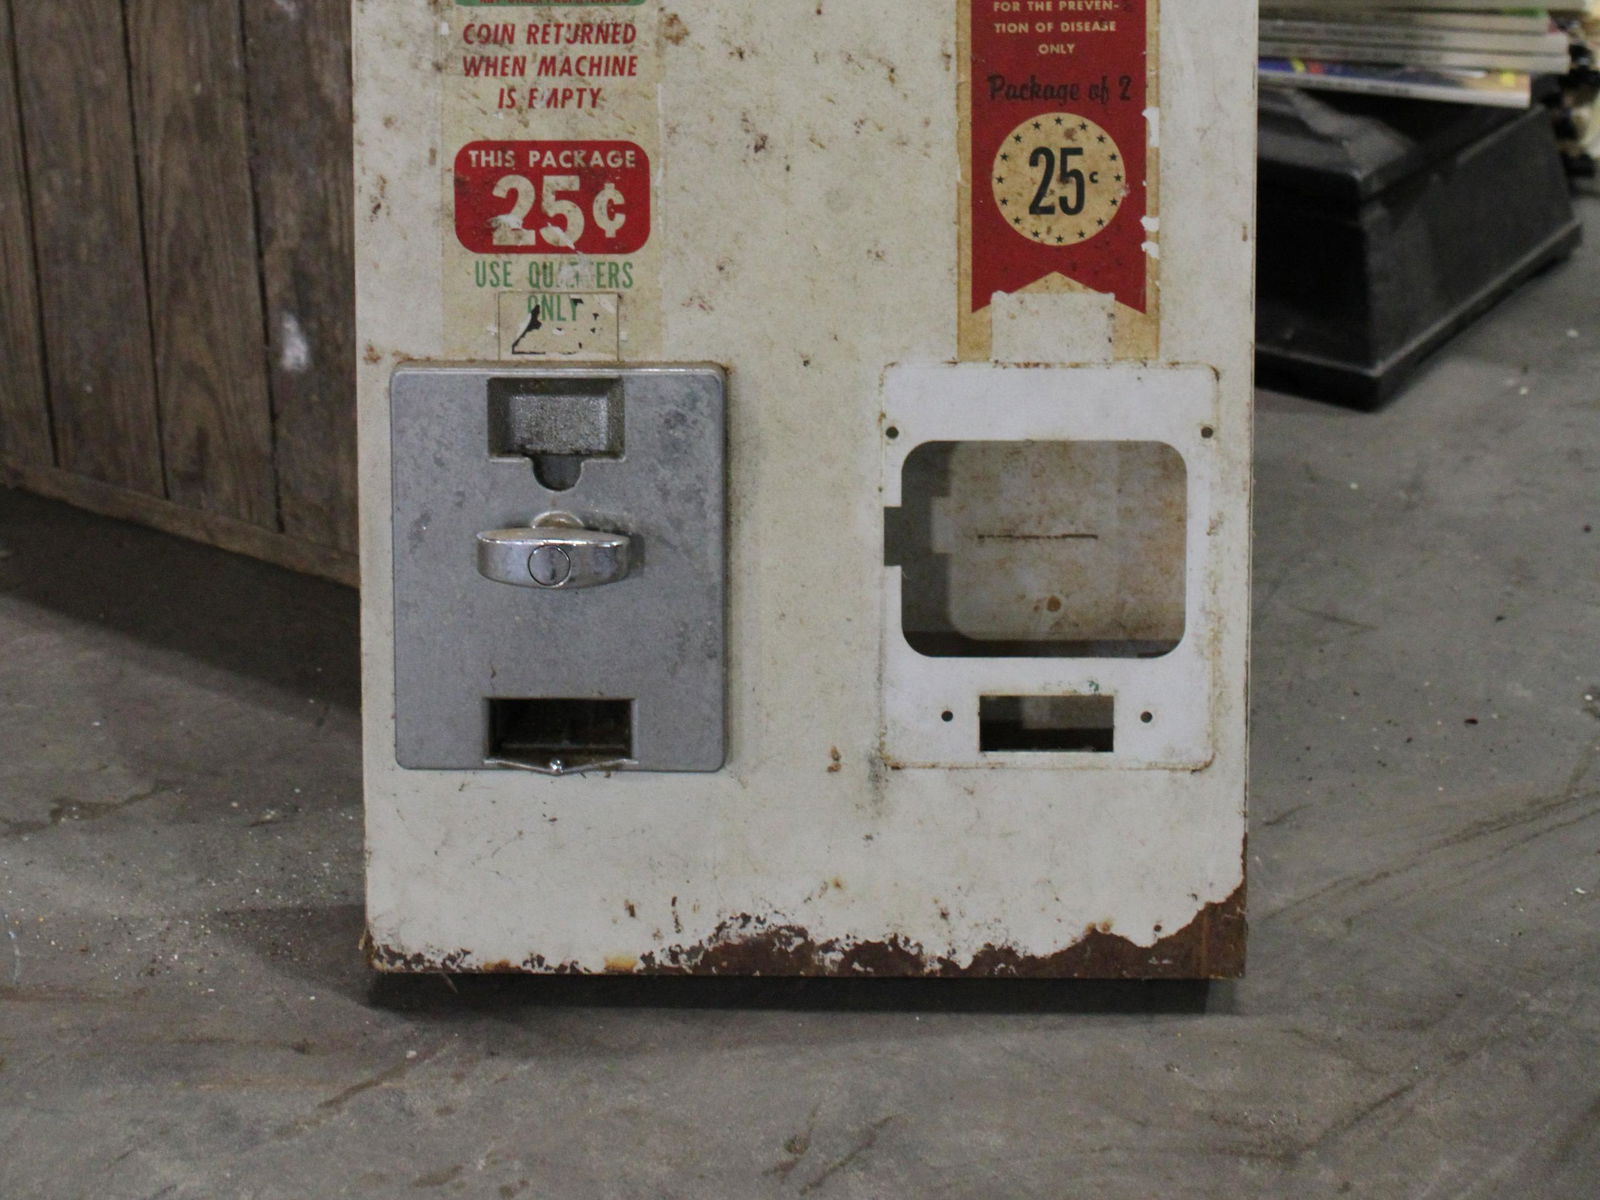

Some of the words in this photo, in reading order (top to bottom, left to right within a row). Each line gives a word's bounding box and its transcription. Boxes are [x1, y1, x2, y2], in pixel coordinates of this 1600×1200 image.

[993, 2, 1021, 12] FOR
[1027, 1, 1053, 11] THE
[1059, 0, 1120, 11] PREVEN-
[463, 23, 516, 45] COIN
[526, 23, 637, 45] RETURNED
[994, 23, 1029, 34] TION
[1035, 22, 1054, 32] OF
[1060, 21, 1117, 32] DISEASE
[1038, 44, 1075, 55] ONLY
[463, 55, 527, 77] WHEN
[537, 55, 638, 77] MACHINE
[498, 87, 517, 109] IS
[987, 73, 1080, 106] Package
[1088, 76, 1109, 105] of
[1118, 75, 1132, 102] 2
[468, 150, 516, 168] THIS
[529, 150, 636, 167] PACKAGE
[474, 261, 513, 288] USE
